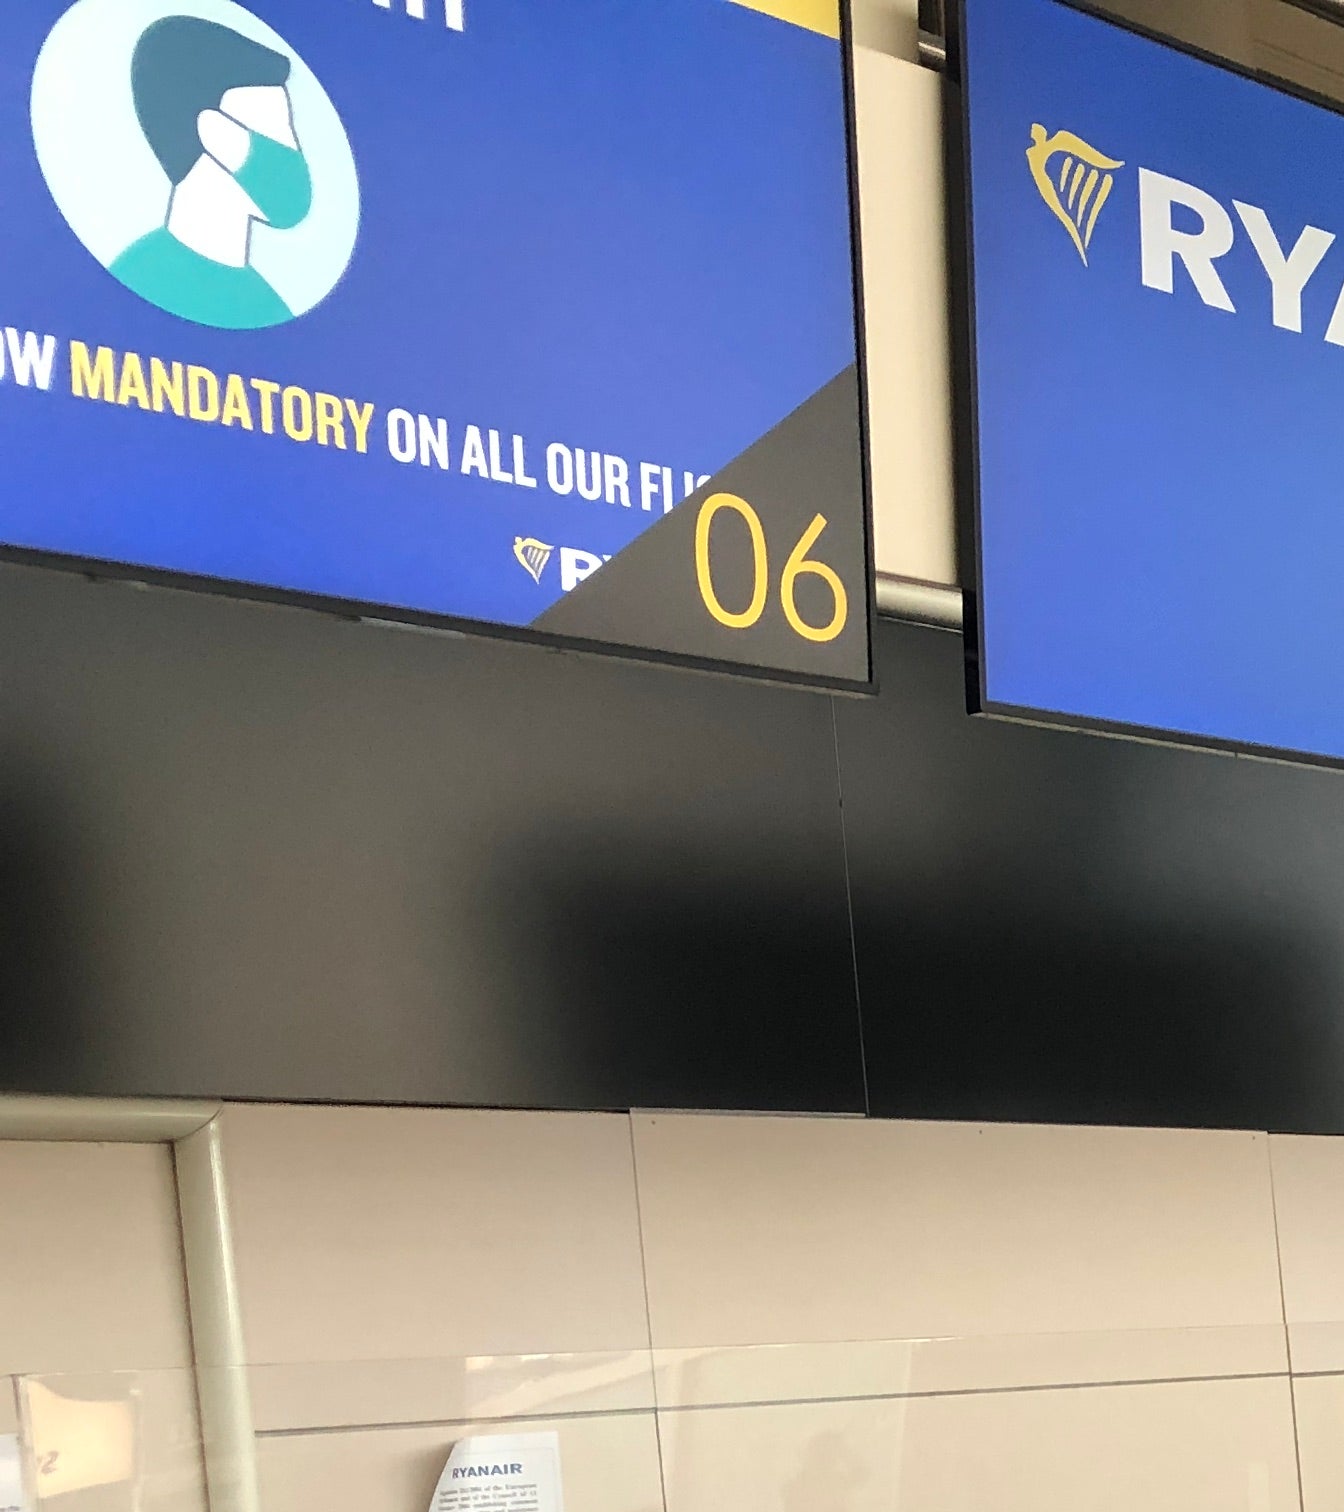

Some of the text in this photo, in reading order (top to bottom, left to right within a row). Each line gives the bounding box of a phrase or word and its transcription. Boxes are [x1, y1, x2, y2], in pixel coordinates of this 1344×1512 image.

[69, 339, 373, 455] MANDATORY
[388, 408, 449, 472] ON
[460, 424, 537, 489] ALL
[546, 442, 632, 508] OUR
[695, 492, 848, 642] 06
[452, 1463, 523, 1479] RYANAIR
